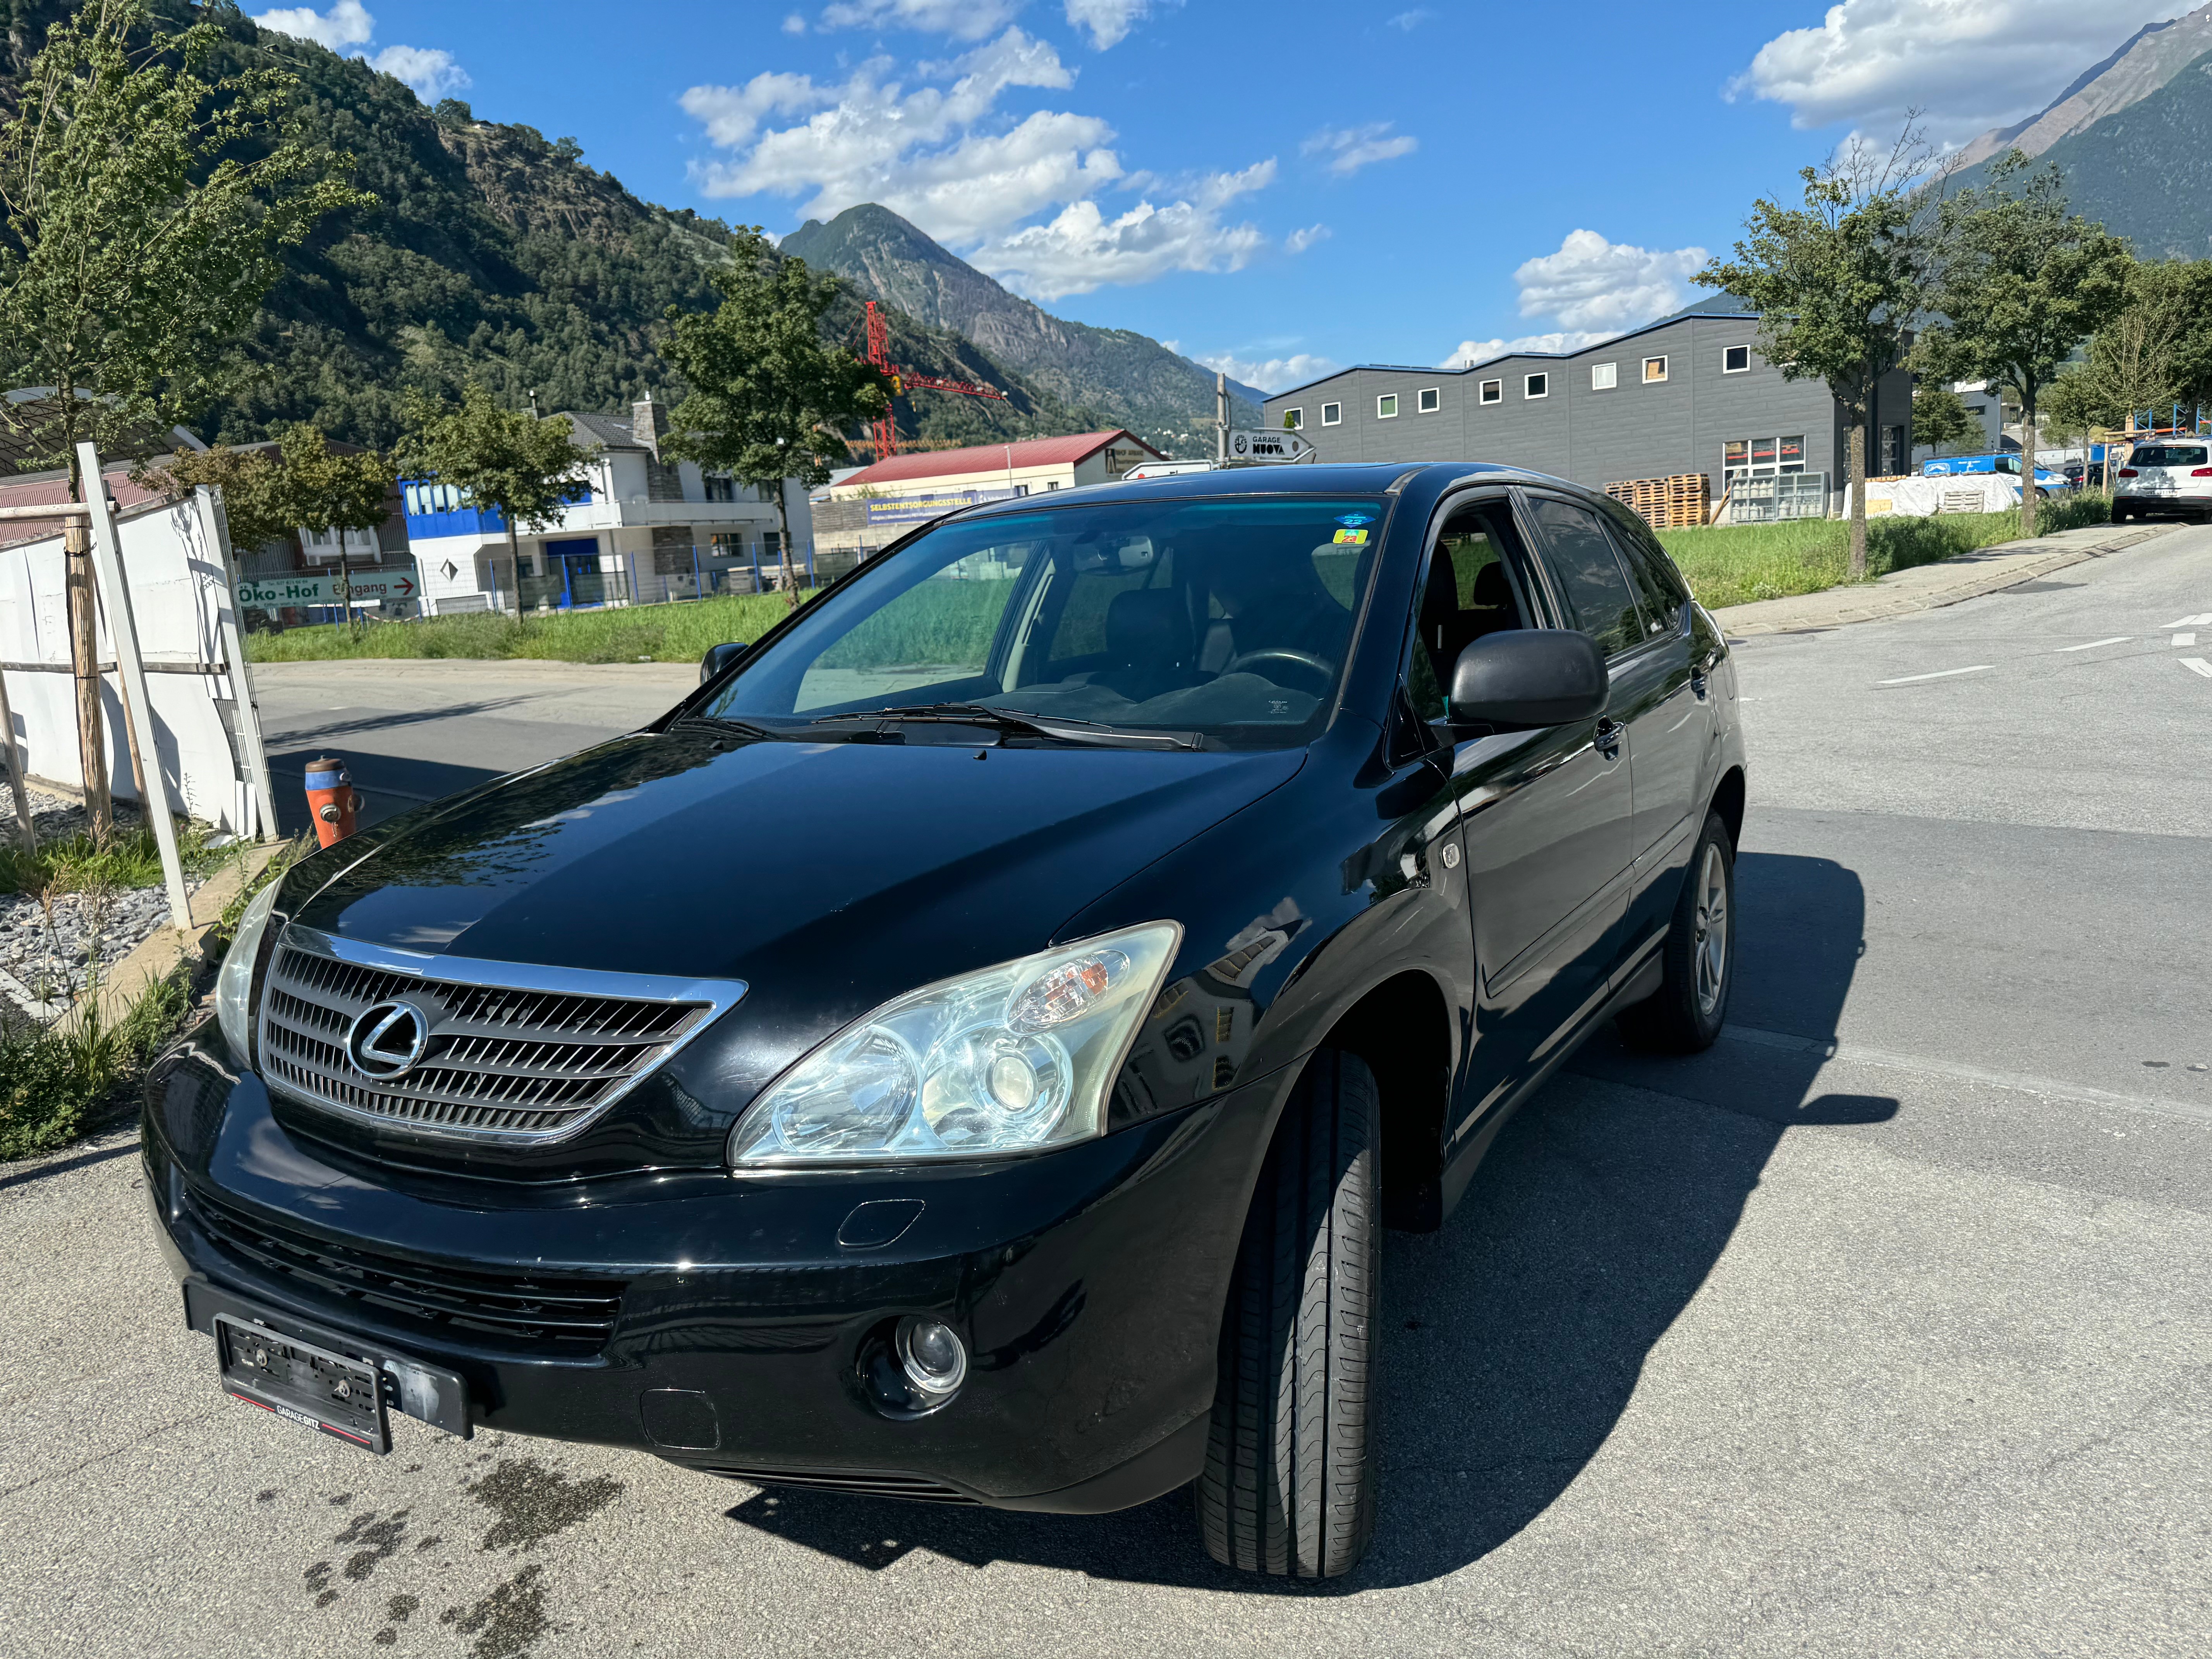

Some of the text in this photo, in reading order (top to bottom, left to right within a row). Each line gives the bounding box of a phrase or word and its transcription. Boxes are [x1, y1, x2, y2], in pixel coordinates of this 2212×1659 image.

[1253, 444, 1285, 455] NUOVA
[870, 497, 972, 511] SELBSTENTSORGUNGSSTELLE
[239, 584, 318, 602] Öko-Hof
